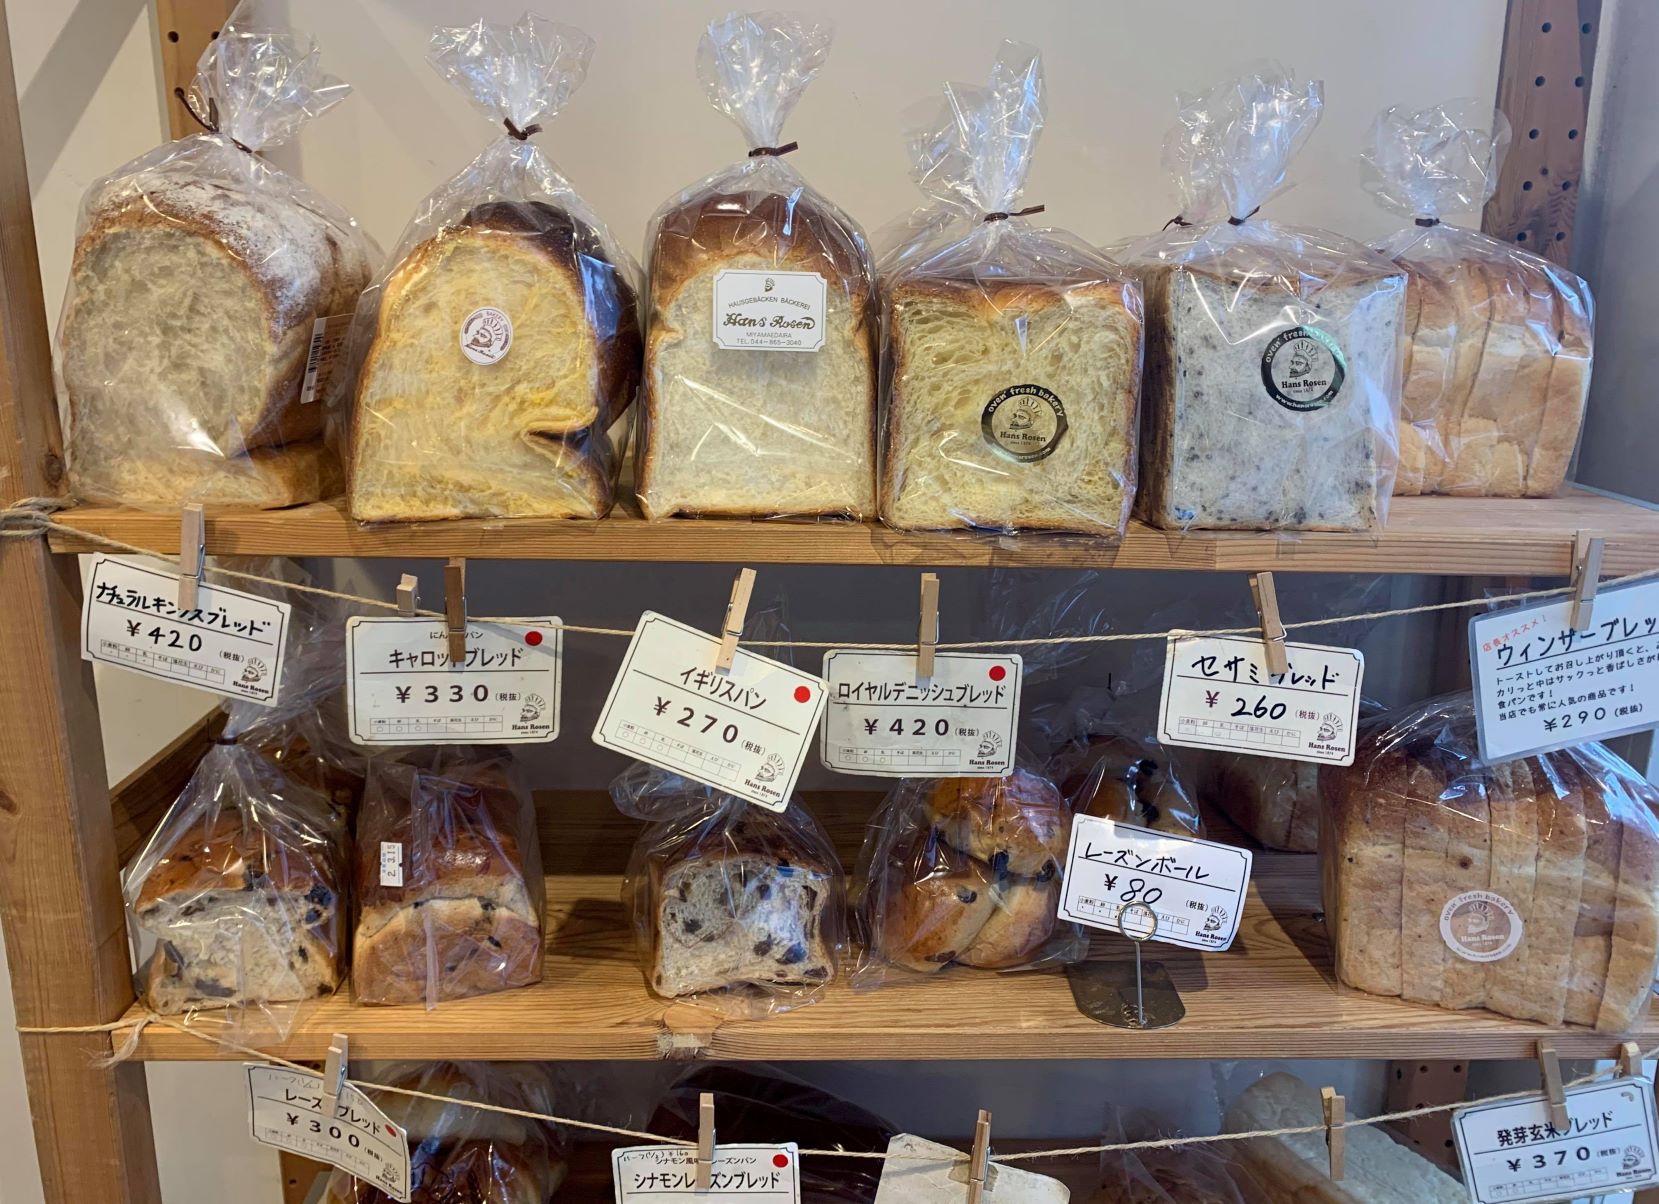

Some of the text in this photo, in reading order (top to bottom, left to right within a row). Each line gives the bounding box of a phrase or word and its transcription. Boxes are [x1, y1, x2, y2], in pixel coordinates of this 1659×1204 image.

[723, 313, 816, 330] Hans Rosen
[1281, 379, 1327, 389] Hans Rosen
[1010, 386, 1037, 396] fresh
[1038, 389, 1064, 417] bakery
[1000, 431, 1046, 442] Hans Rosen
[126, 619, 203, 652] ¥420
[429, 631, 484, 640] にんパン
[389, 647, 524, 669] キャロッブレッド
[232, 680, 249, 689] Hans
[250, 685, 269, 694] Rosen
[680, 666, 767, 710] イギリスパン
[838, 681, 1006, 704] ロイヤルデニッシュブレッド
[512, 723, 550, 731] Hans Rosen
[1543, 707, 1606, 733] ¥290
[1308, 741, 1346, 753] Hans Rosen
[744, 778, 761, 791] Hans
[761, 783, 781, 798] Rosen
[1084, 842, 1210, 880] レーズンボール
[1104, 873, 1163, 905] ¥80
[1458, 892, 1483, 903] fresh
[1485, 894, 1514, 915] bakery
[1195, 931, 1209, 939] Hans
[634, 1172, 781, 1189] シナモンレズンブレッド
